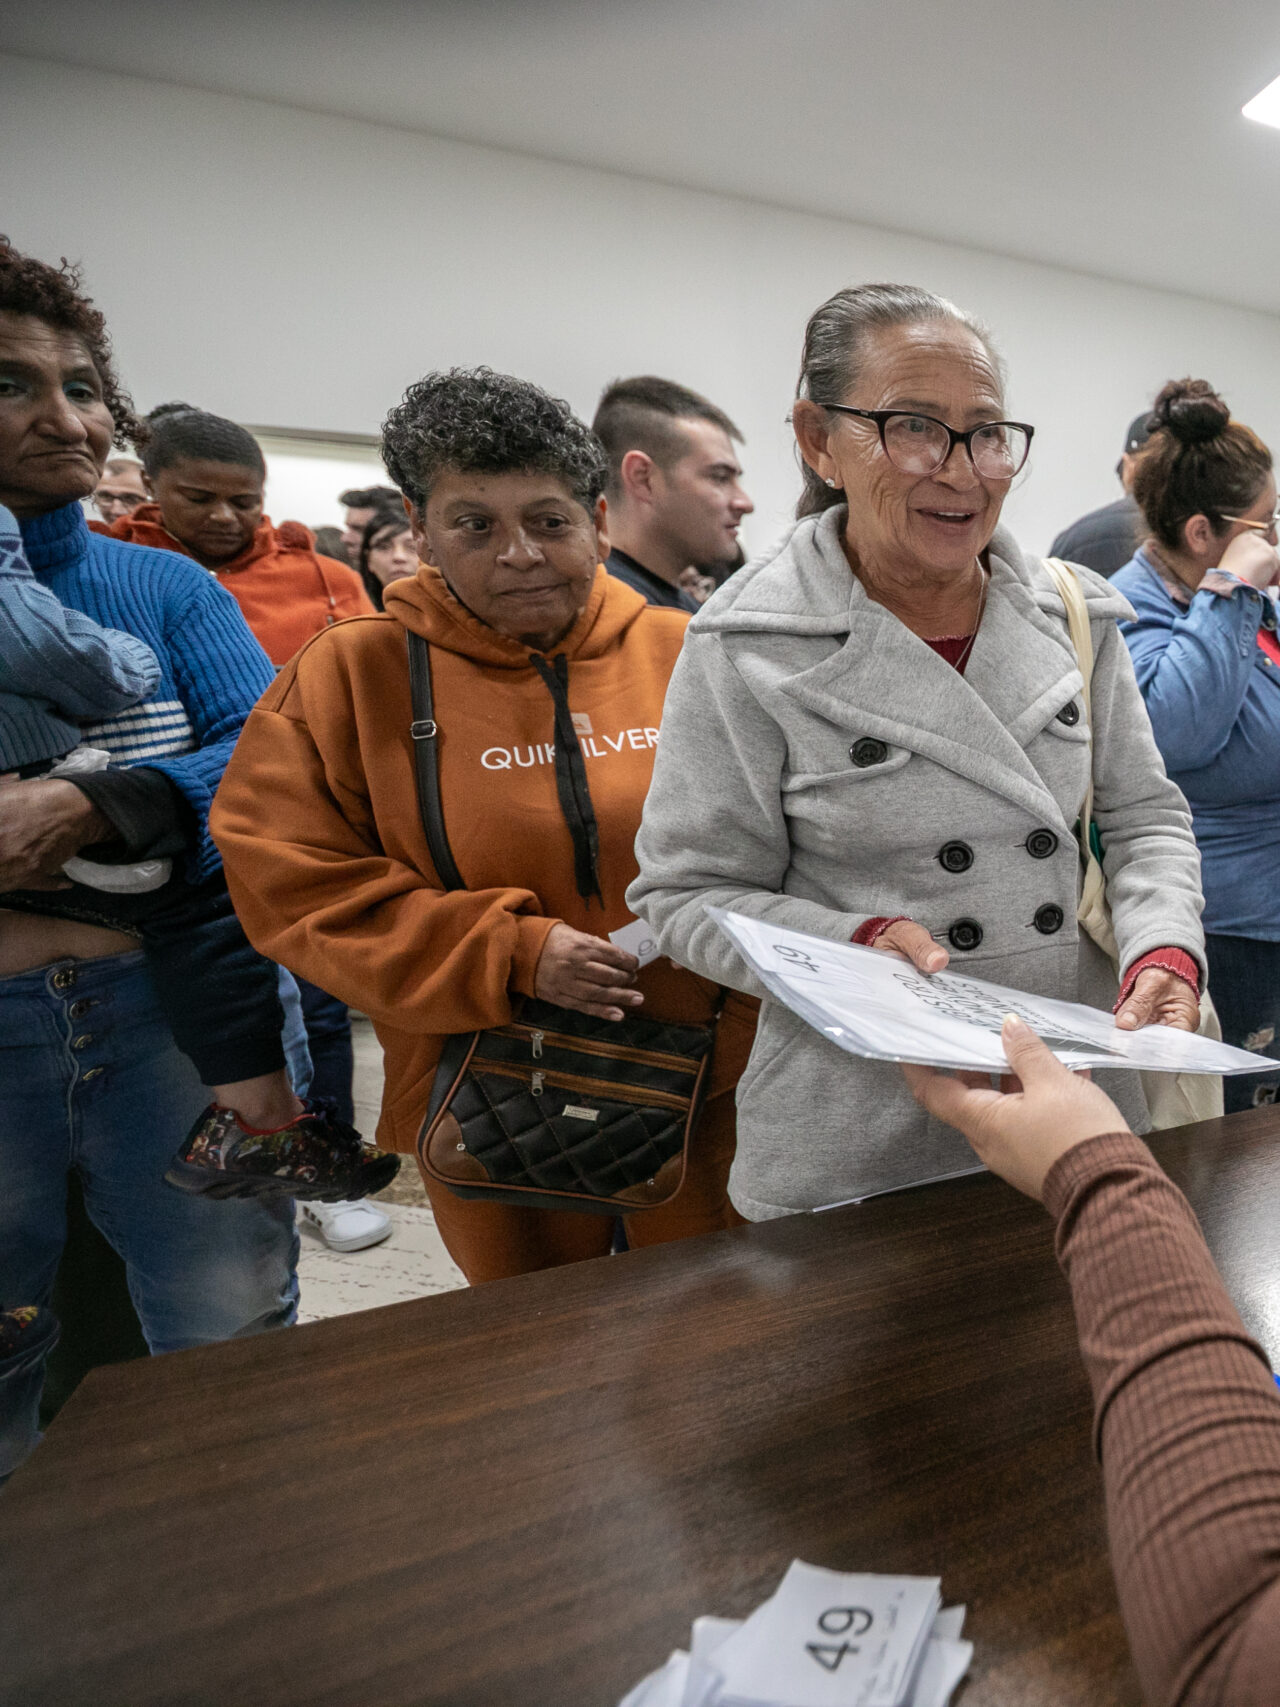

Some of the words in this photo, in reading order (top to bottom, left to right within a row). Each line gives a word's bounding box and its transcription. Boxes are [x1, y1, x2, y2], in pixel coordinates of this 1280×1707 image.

[480, 727, 660, 770] QUIKILVER
[772, 945, 820, 973] 49
[805, 1605, 873, 1673] 49
